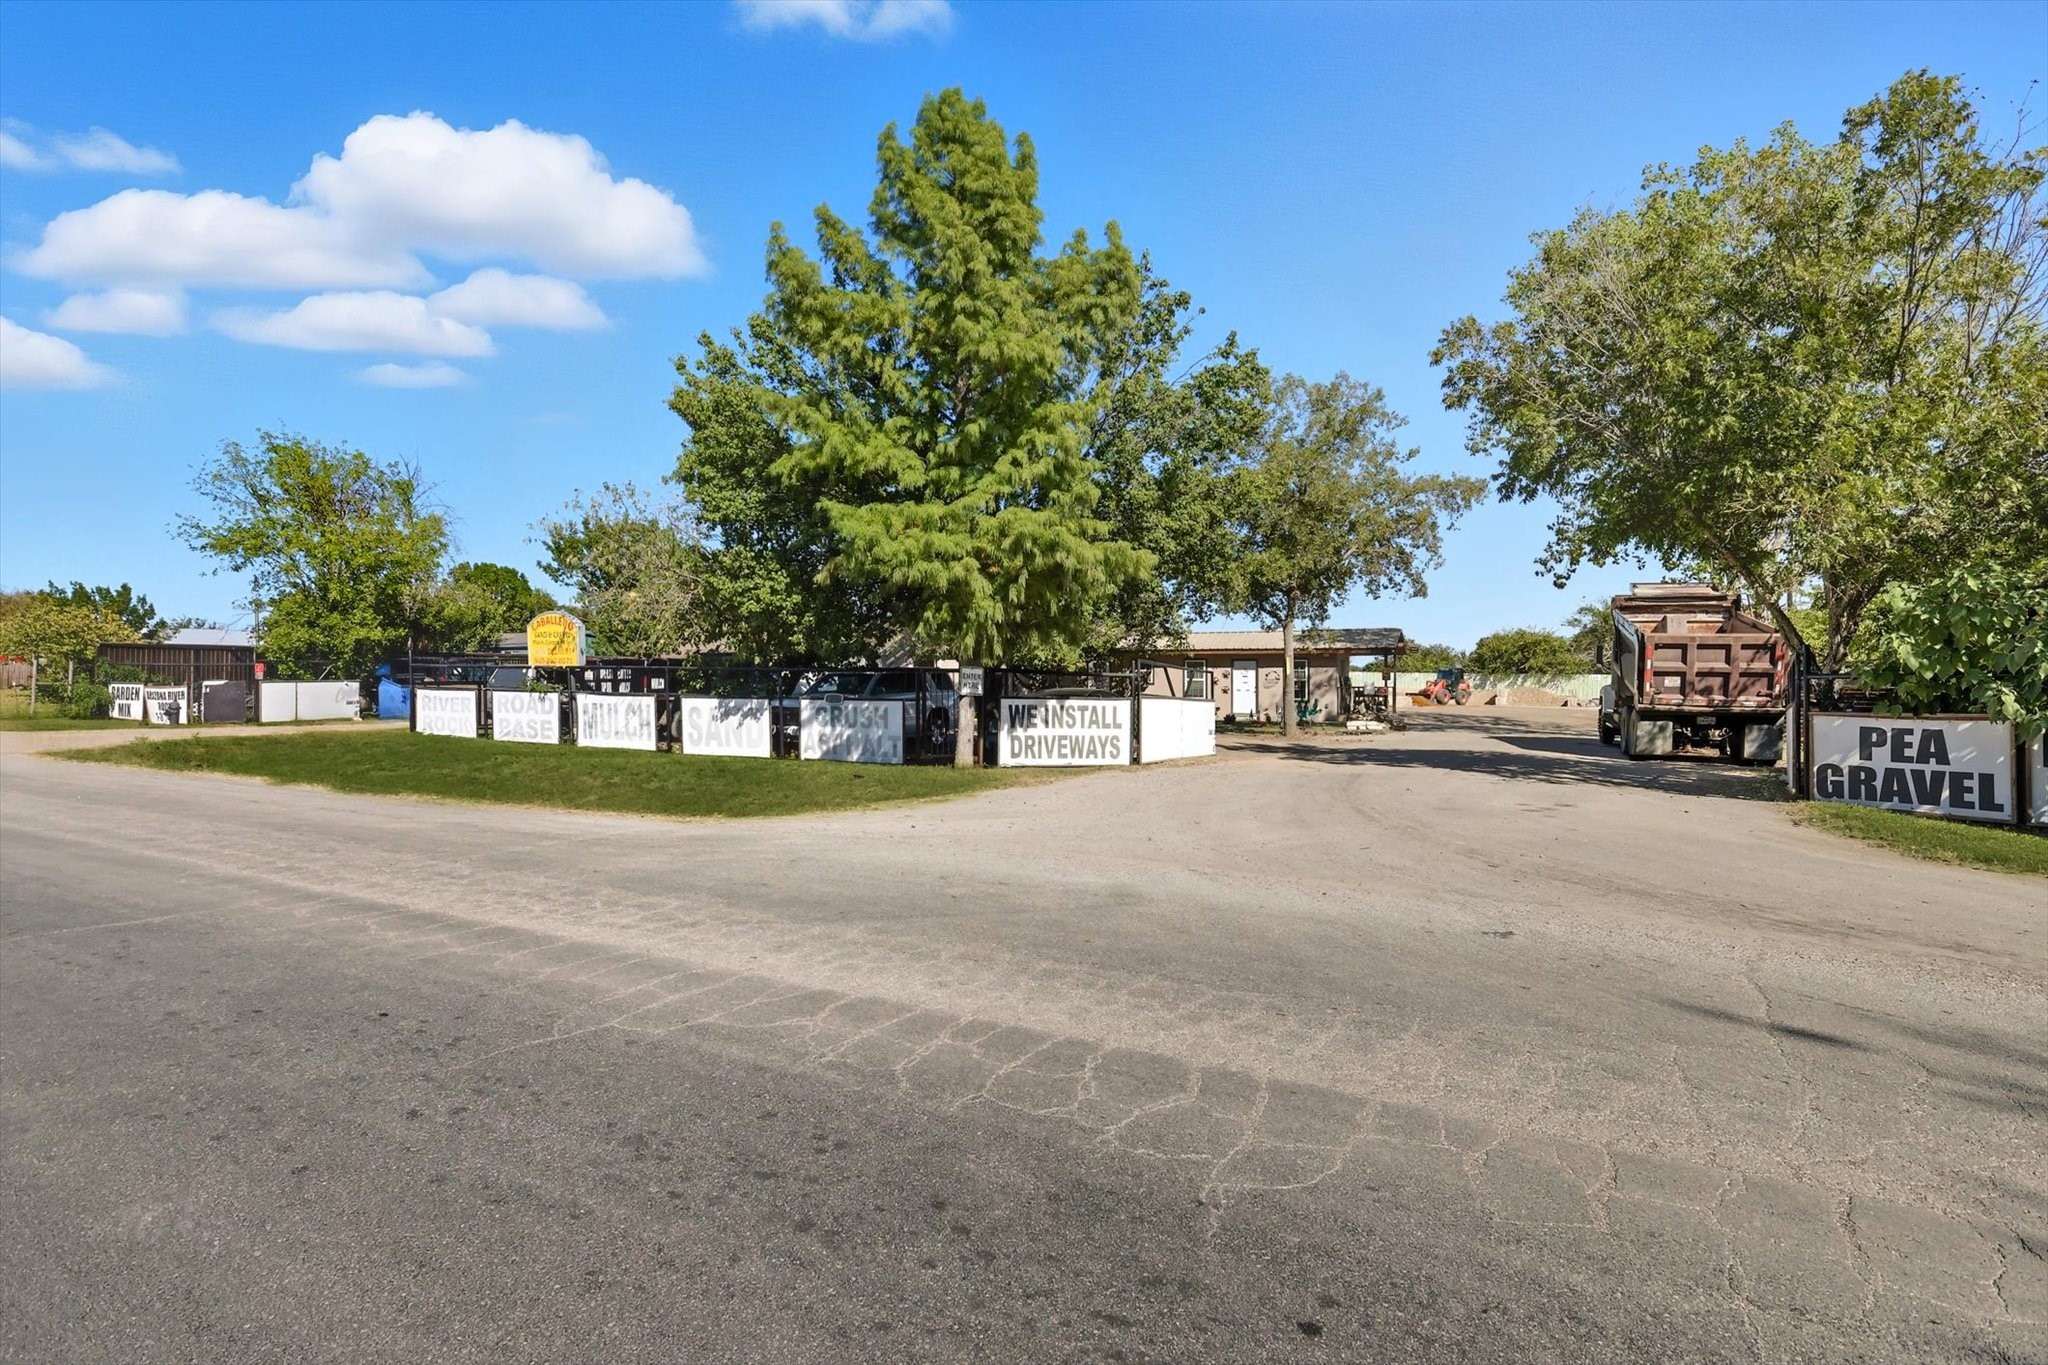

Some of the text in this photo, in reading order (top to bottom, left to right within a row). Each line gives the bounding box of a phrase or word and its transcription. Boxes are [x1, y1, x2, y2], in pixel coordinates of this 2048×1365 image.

[118, 702, 132, 718] MIX
[421, 694, 472, 713] RIVER
[497, 693, 555, 715] ROAD
[583, 702, 652, 741] MULCH
[688, 706, 764, 748] SAND
[815, 705, 889, 729] CRUSH
[1008, 704, 1123, 729] WE INSTALL
[1010, 734, 1121, 760] DRIVEWAYS
[1859, 726, 1951, 765] PEA
[1816, 762, 2004, 812] GRAVEL
